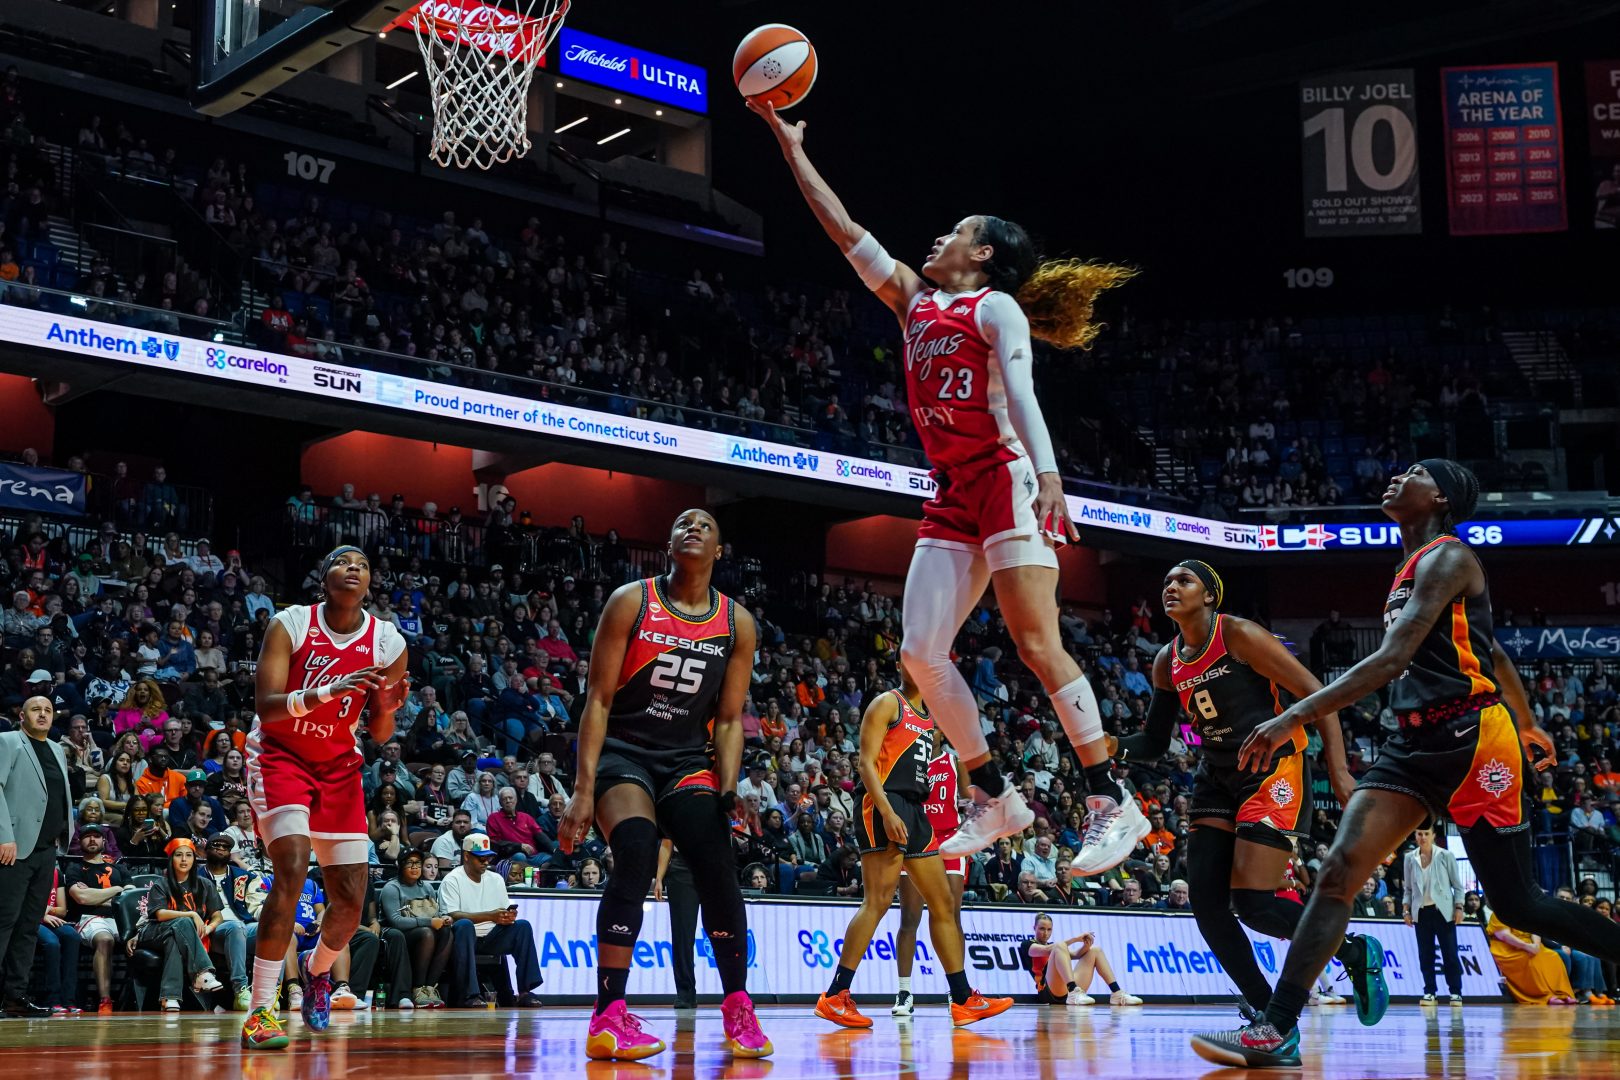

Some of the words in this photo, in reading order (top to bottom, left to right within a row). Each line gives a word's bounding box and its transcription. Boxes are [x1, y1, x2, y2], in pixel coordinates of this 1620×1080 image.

[565, 44, 627, 72] Michelob
[643, 63, 701, 95] ULTRA
[1302, 86, 1354, 103] BILLY
[1360, 83, 1411, 100] JOEL
[1457, 91, 1518, 106] ARENA
[1521, 88, 1544, 103] OF
[1459, 107, 1495, 122] THE
[1498, 106, 1544, 121] YEAR
[1527, 129, 1551, 139] 2010
[1303, 104, 1416, 192] 10
[284, 151, 336, 184] 107
[1312, 198, 1342, 208] SOLD
[1344, 197, 1367, 207] OUT
[1370, 195, 1413, 205] SHOWS
[1338, 207, 1380, 216] ENGLAND
[1382, 205, 1417, 214] RECORD
[1283, 267, 1334, 289] 109
[953, 305, 972, 316] ally
[47, 323, 138, 355] Anthem
[907, 320, 966, 380] Vegas
[227, 354, 288, 377] carelon
[313, 366, 361, 378] CONNECTICUT
[314, 373, 361, 394] SUN
[938, 367, 973, 399] 23
[415, 389, 459, 410] Proud
[463, 401, 519, 420] partner
[523, 409, 538, 423] of
[541, 412, 565, 428] the
[568, 417, 650, 443] Connecticut
[653, 431, 678, 447] Sun
[914, 406, 955, 427] IPSY
[731, 443, 792, 467] Anthem
[850, 464, 892, 481] carelon
[0, 479, 74, 505] rena
[1081, 505, 1129, 525] Anthem
[1177, 521, 1211, 535] carelon
[1224, 532, 1257, 545] SUN
[1468, 526, 1503, 545] 36
[355, 645, 370, 654] ally
[639, 630, 725, 657] KEESUSK
[1537, 628, 1620, 657] Moheg
[305, 650, 330, 670] Las
[650, 653, 707, 694] 25
[1176, 664, 1232, 692] KEESUSK
[339, 696, 352, 718] 3
[646, 706, 673, 720] Health
[1194, 689, 1218, 720] 8
[293, 718, 339, 739] IPSY
[939, 786, 947, 801] 0
[924, 804, 945, 814] PSY
[968, 945, 1029, 971] SU
[920, 965, 933, 975] Rx
